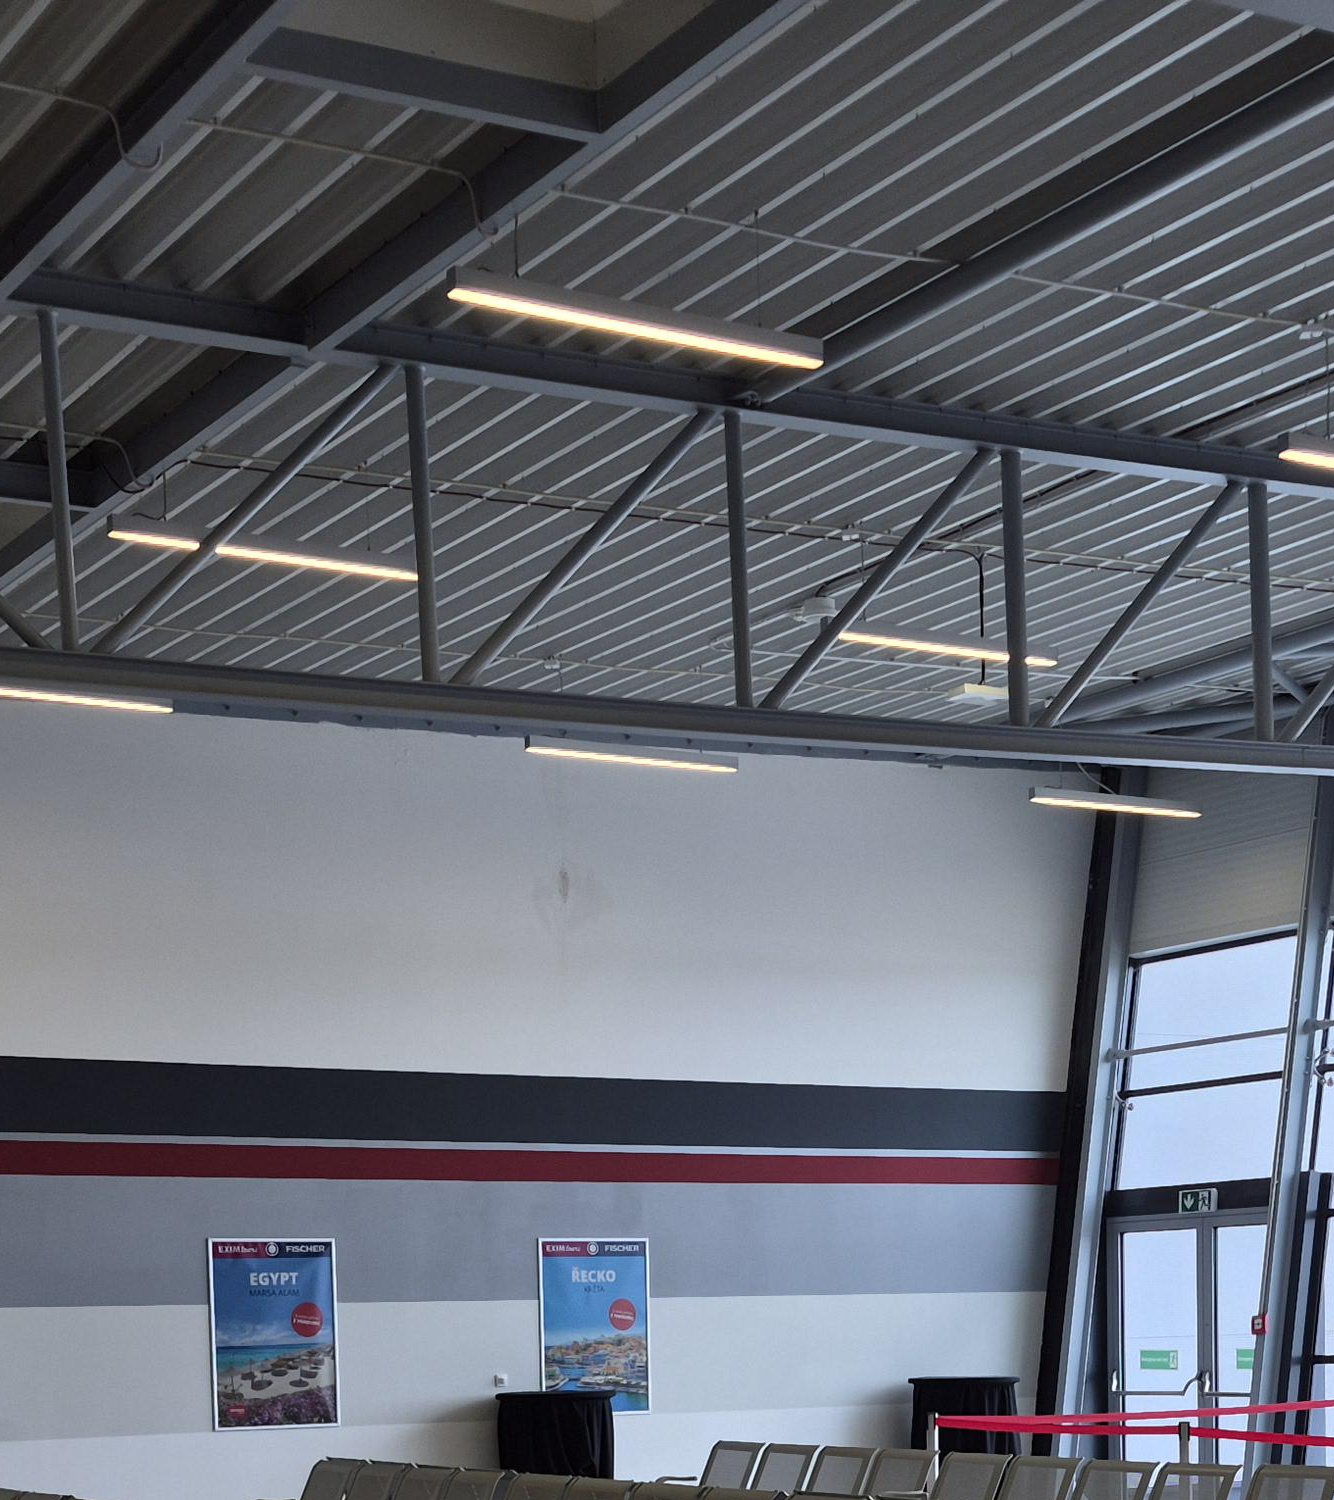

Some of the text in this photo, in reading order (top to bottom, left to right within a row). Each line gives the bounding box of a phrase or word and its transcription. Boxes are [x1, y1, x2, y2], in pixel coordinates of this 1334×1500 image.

[286, 1245, 325, 1253] FISCHER
[249, 1272, 299, 1286] EGYPT
[571, 1265, 616, 1283] ŘECKO
